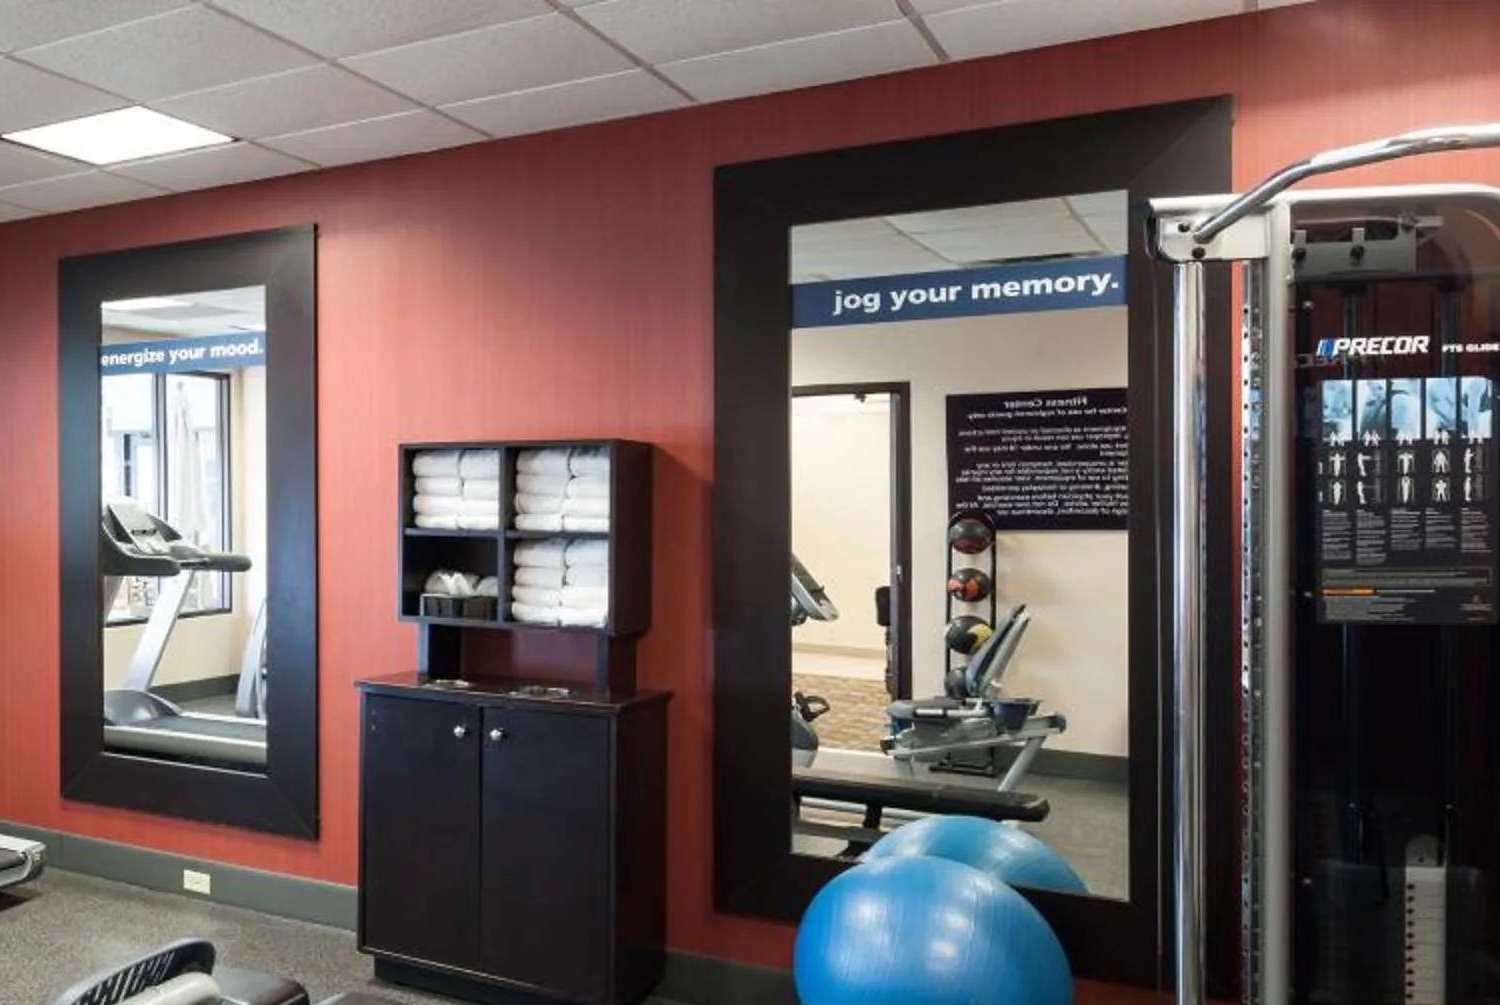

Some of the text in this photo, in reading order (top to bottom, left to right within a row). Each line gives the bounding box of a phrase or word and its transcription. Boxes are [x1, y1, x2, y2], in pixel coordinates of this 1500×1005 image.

[832, 273, 1120, 315] jog your memory.
[100, 338, 263, 367] energize your mood.
[1331, 335, 1431, 356] PRECOR
